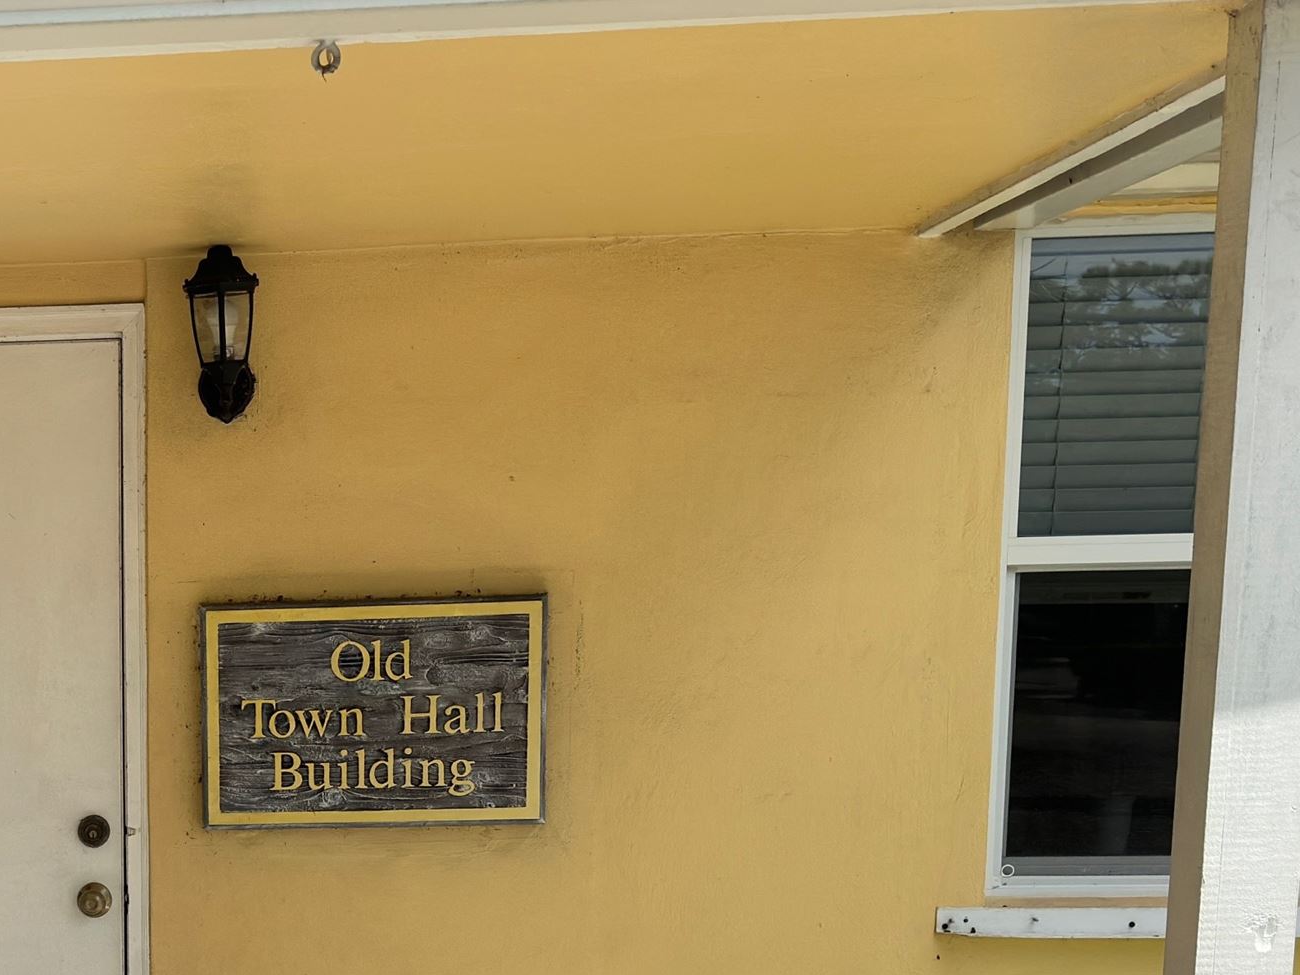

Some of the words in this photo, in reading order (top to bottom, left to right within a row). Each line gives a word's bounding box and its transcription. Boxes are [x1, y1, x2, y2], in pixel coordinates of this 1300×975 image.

[330, 639, 413, 682] Old
[241, 698, 366, 739] Town
[400, 691, 504, 735] Hall
[269, 747, 476, 797] Building
